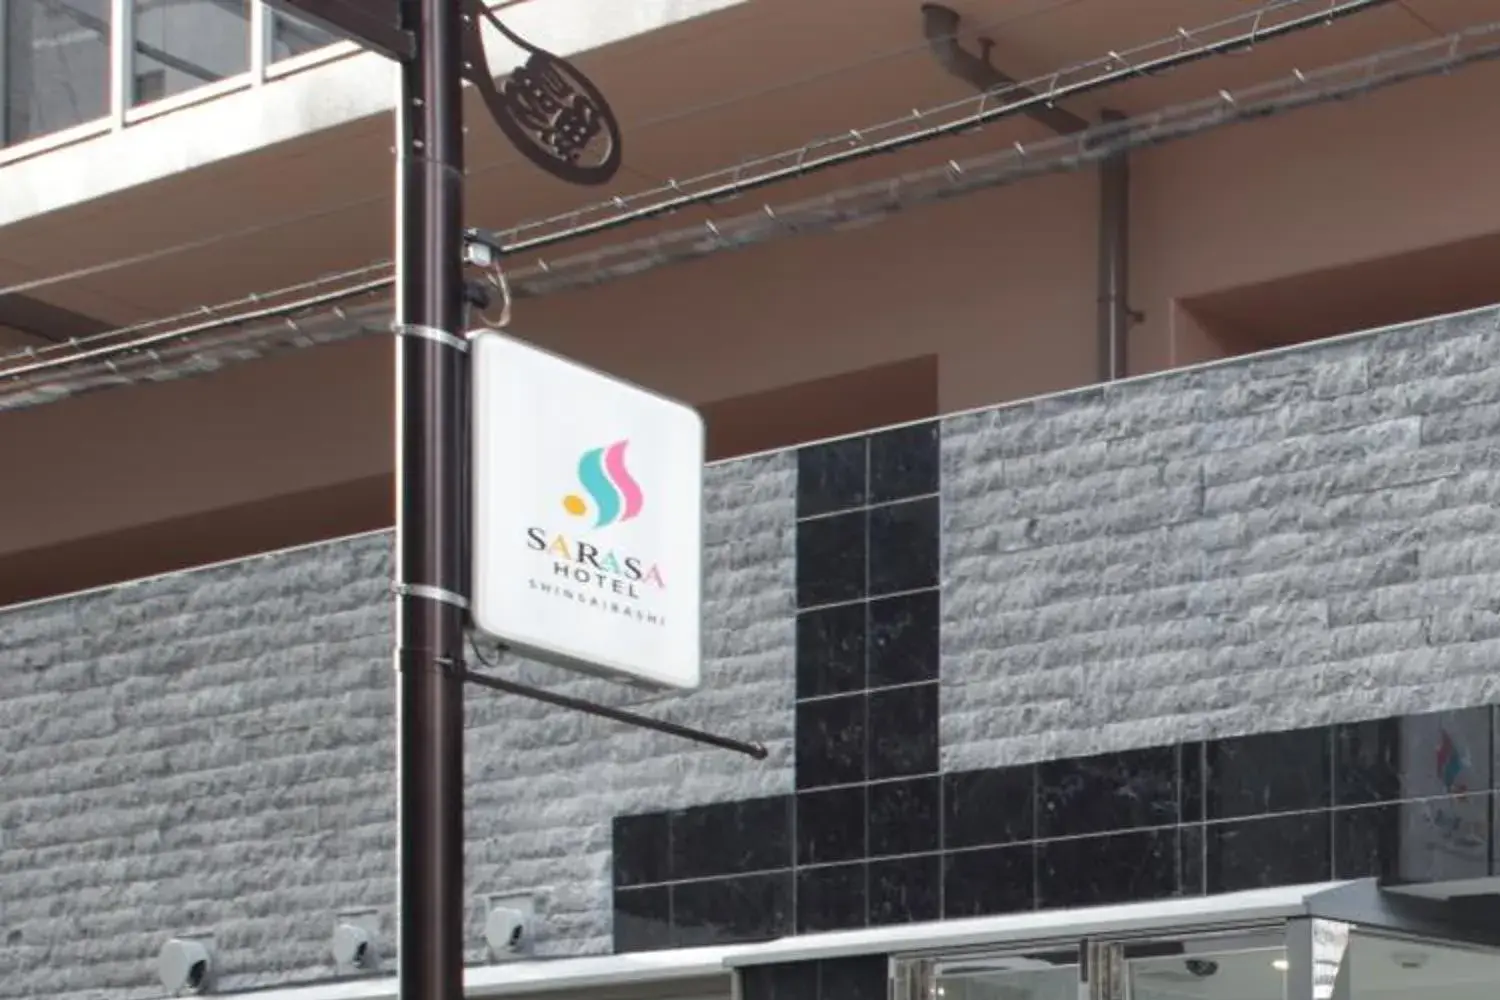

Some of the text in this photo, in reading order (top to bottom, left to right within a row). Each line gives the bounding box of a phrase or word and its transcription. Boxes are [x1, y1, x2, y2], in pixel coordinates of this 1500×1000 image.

[527, 527, 666, 588] SARASA
[553, 561, 640, 599] HOTEL
[529, 578, 666, 626] SHINSAIBASHI
